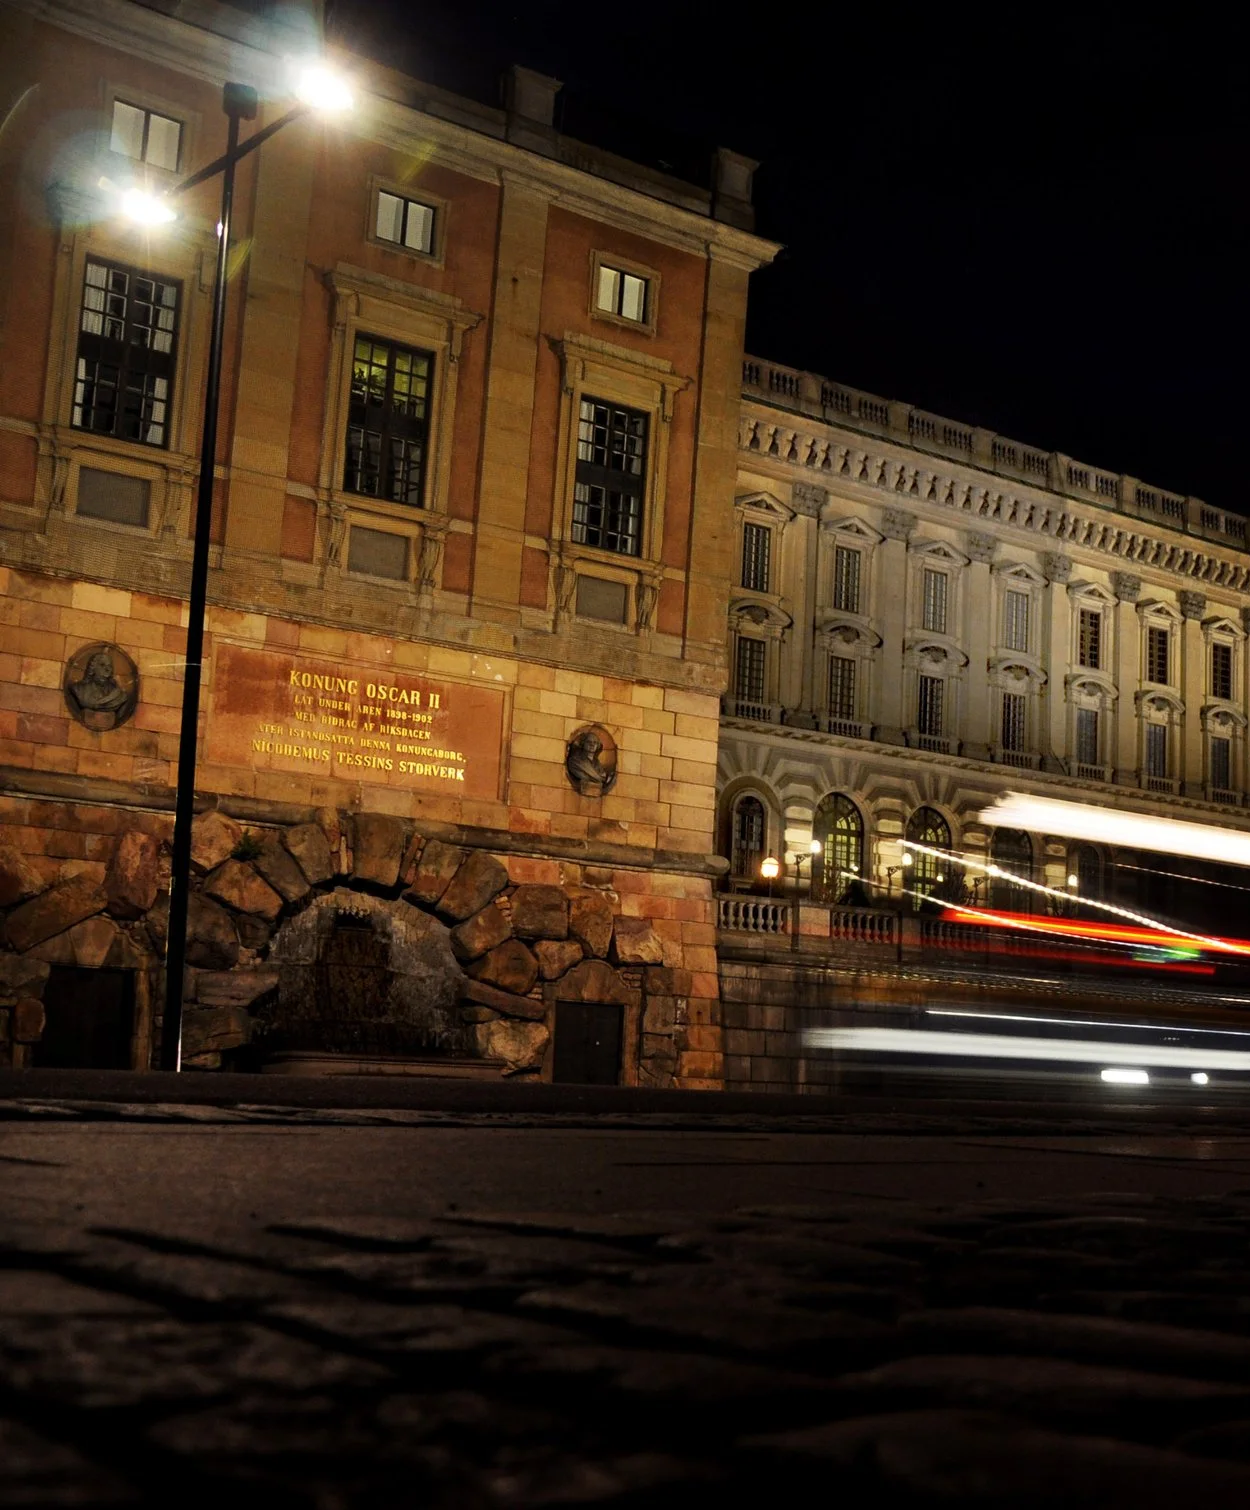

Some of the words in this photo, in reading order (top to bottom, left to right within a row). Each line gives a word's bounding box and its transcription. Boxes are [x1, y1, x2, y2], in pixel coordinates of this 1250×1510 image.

[290, 670, 358, 695] KONUNG
[366, 683, 421, 706] OSCAR
[429, 692, 440, 709] II
[295, 711, 316, 722] MED
[362, 721, 376, 732] AF
[319, 698, 351, 712] UNDER
[386, 708, 433, 724] 1898-1902
[360, 738, 391, 751] DENNA
[251, 739, 331, 761] NICODEMUS
[336, 752, 394, 771] TESSINS
[399, 761, 465, 781] STORVERK
